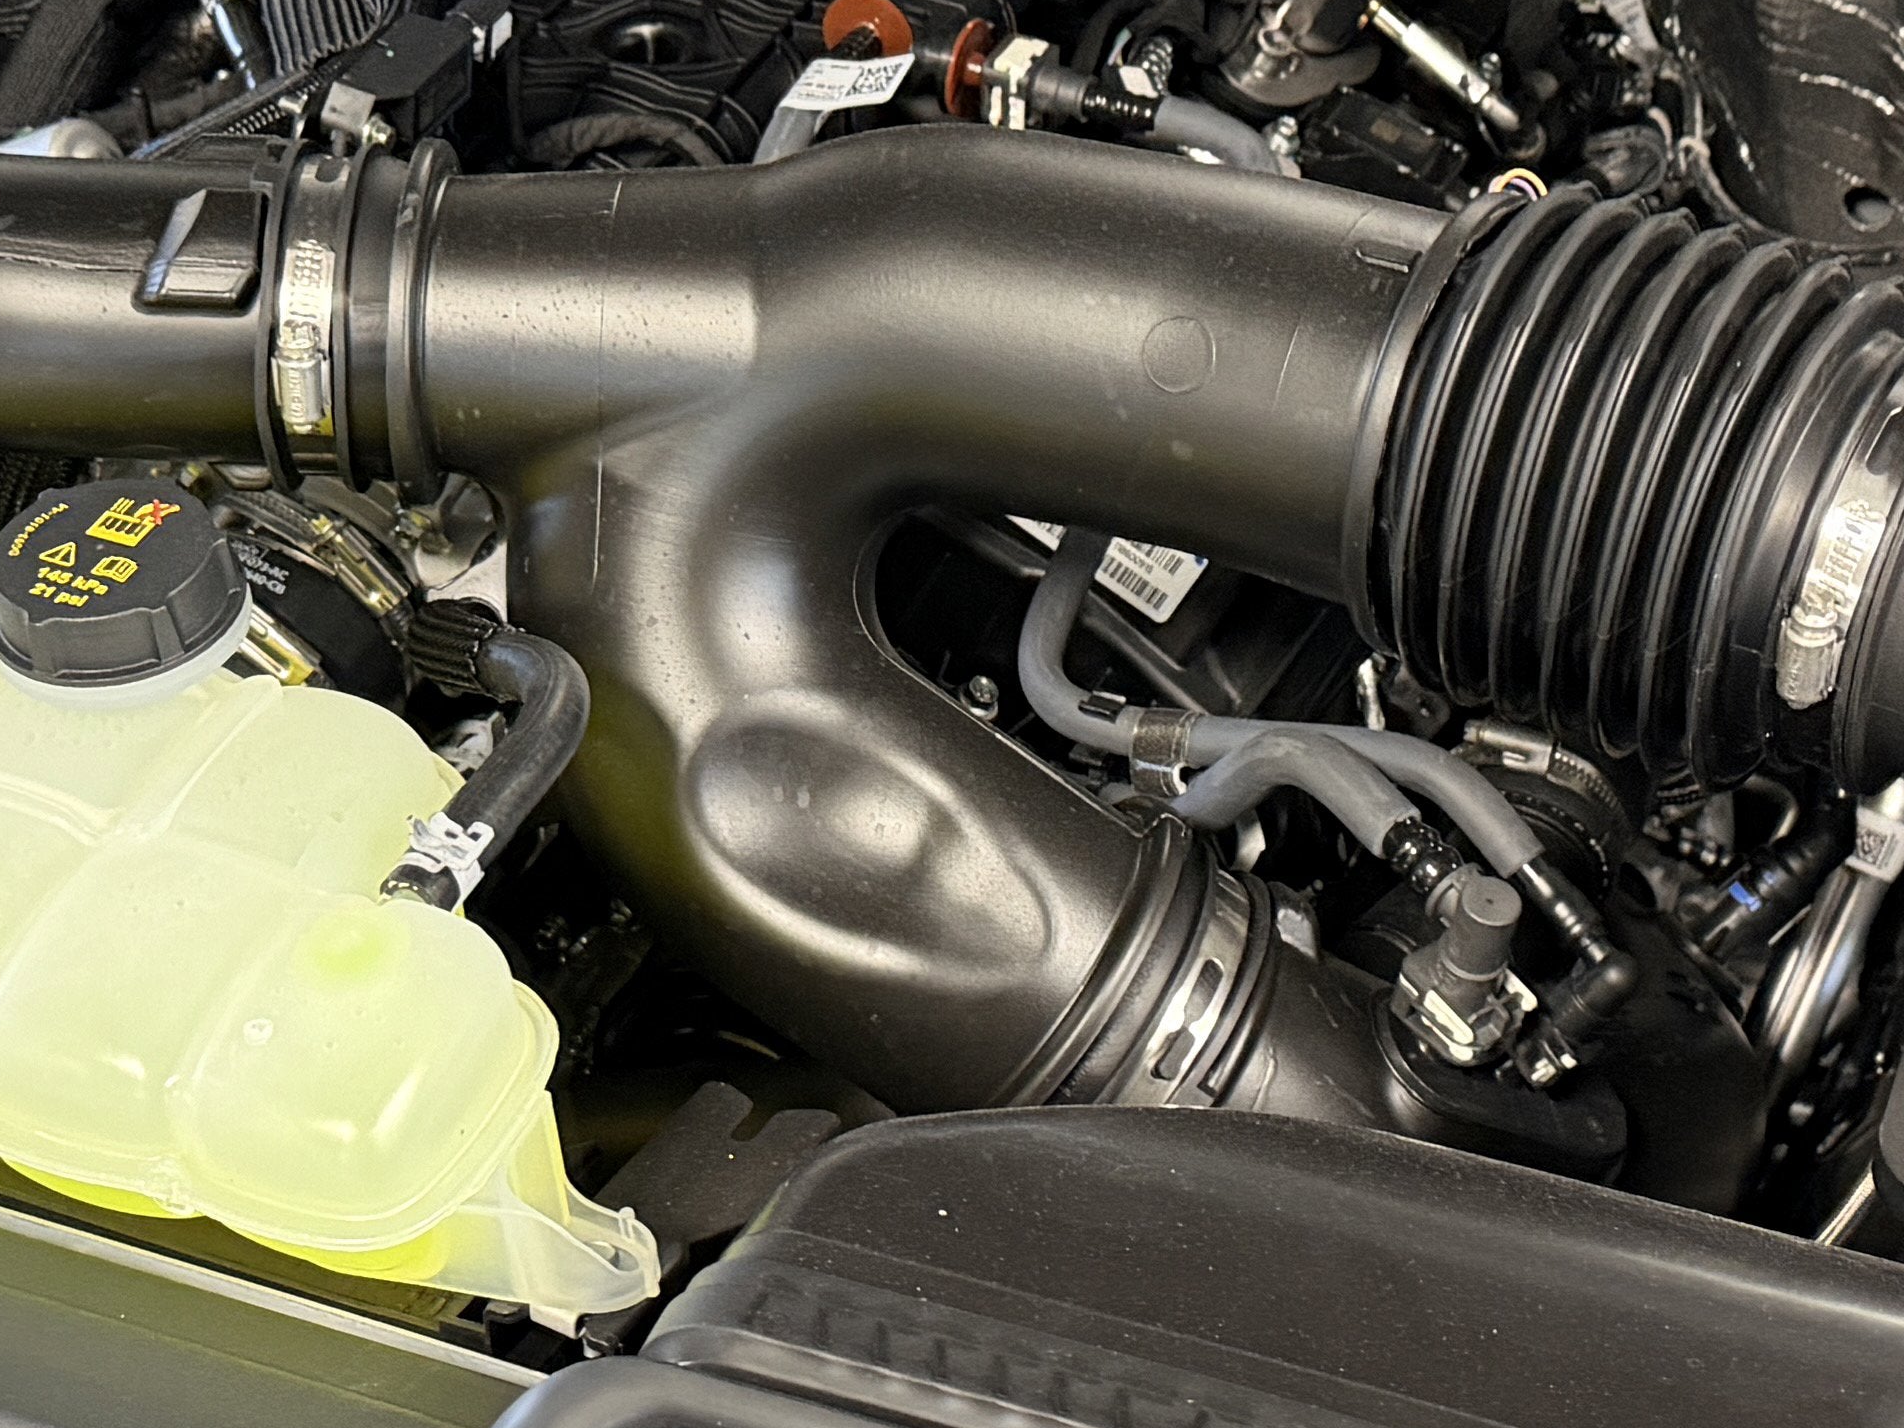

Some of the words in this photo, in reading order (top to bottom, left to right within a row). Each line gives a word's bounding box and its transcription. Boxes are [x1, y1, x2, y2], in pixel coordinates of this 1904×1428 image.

[37, 566, 74, 585] 145
[71, 575, 110, 595] kPa
[28, 582, 57, 598] 21
[53, 591, 89, 607] psi
